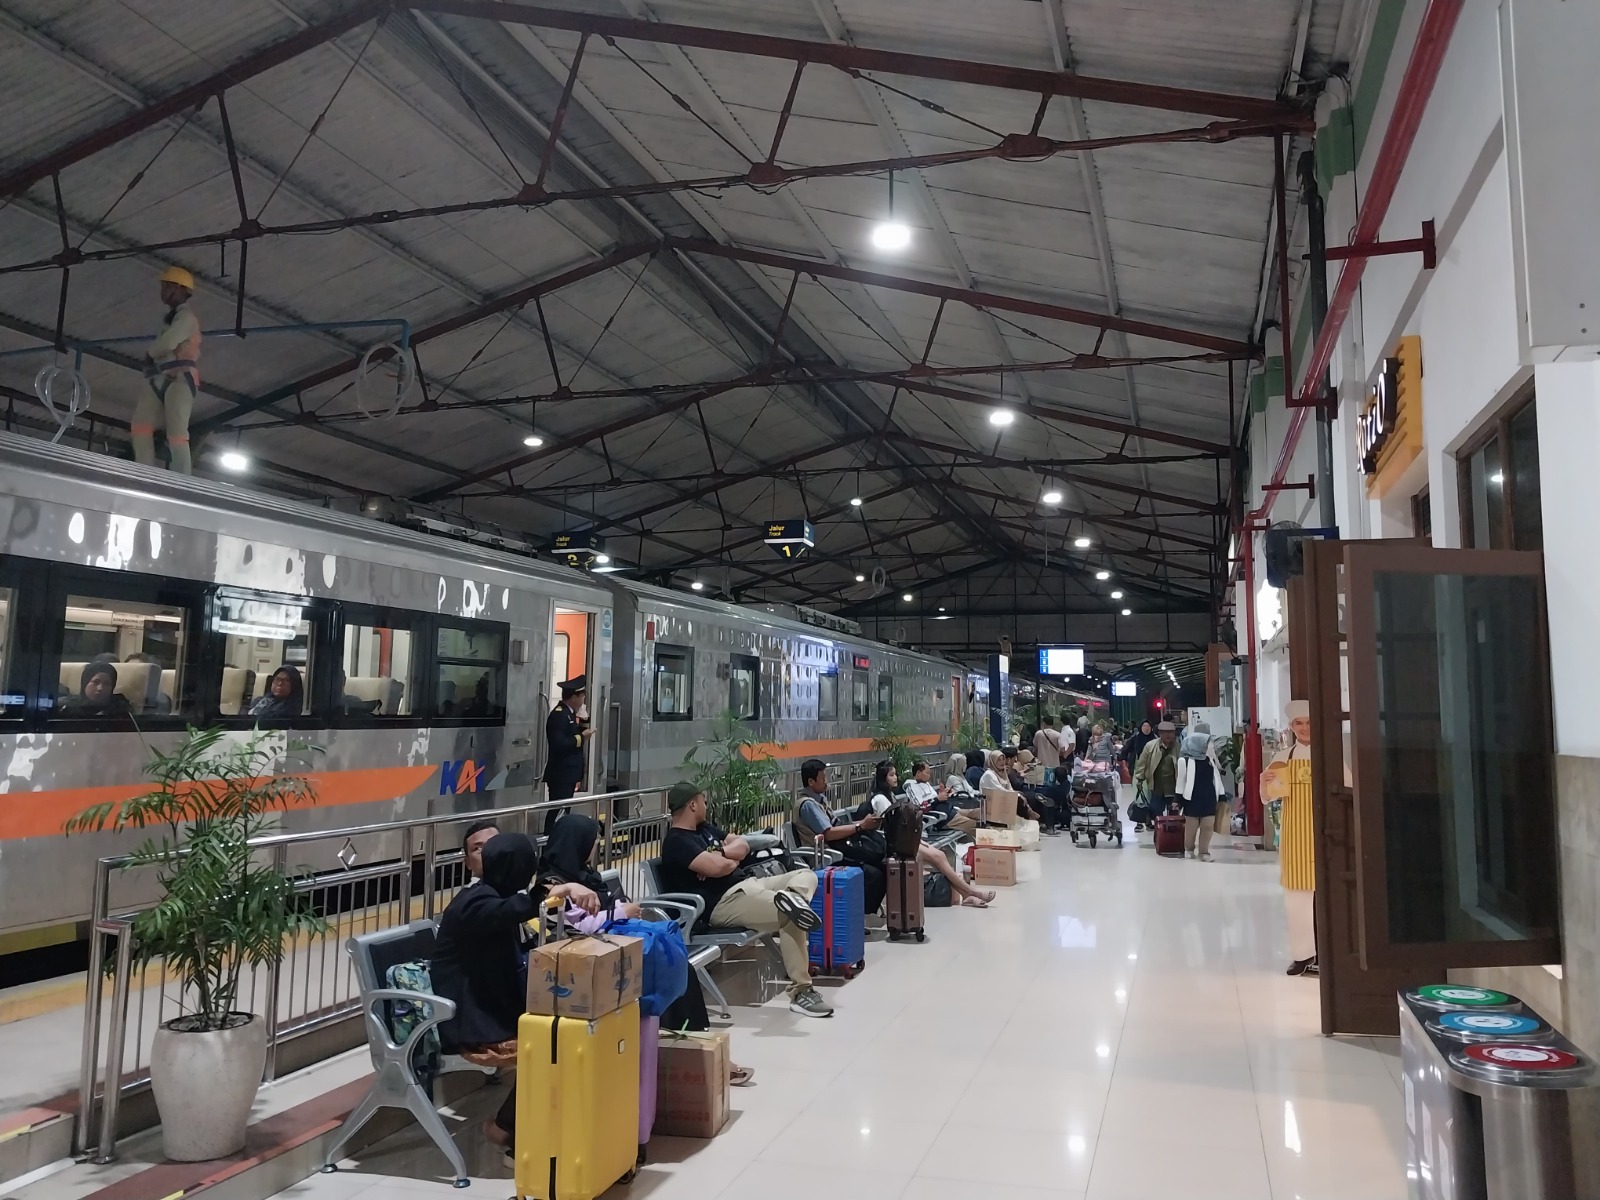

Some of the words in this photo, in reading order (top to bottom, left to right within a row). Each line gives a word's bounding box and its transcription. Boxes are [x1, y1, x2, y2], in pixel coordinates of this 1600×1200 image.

[782, 545, 791, 557] 1
[567, 554, 580, 566] 2
[440, 759, 486, 796] KAI
